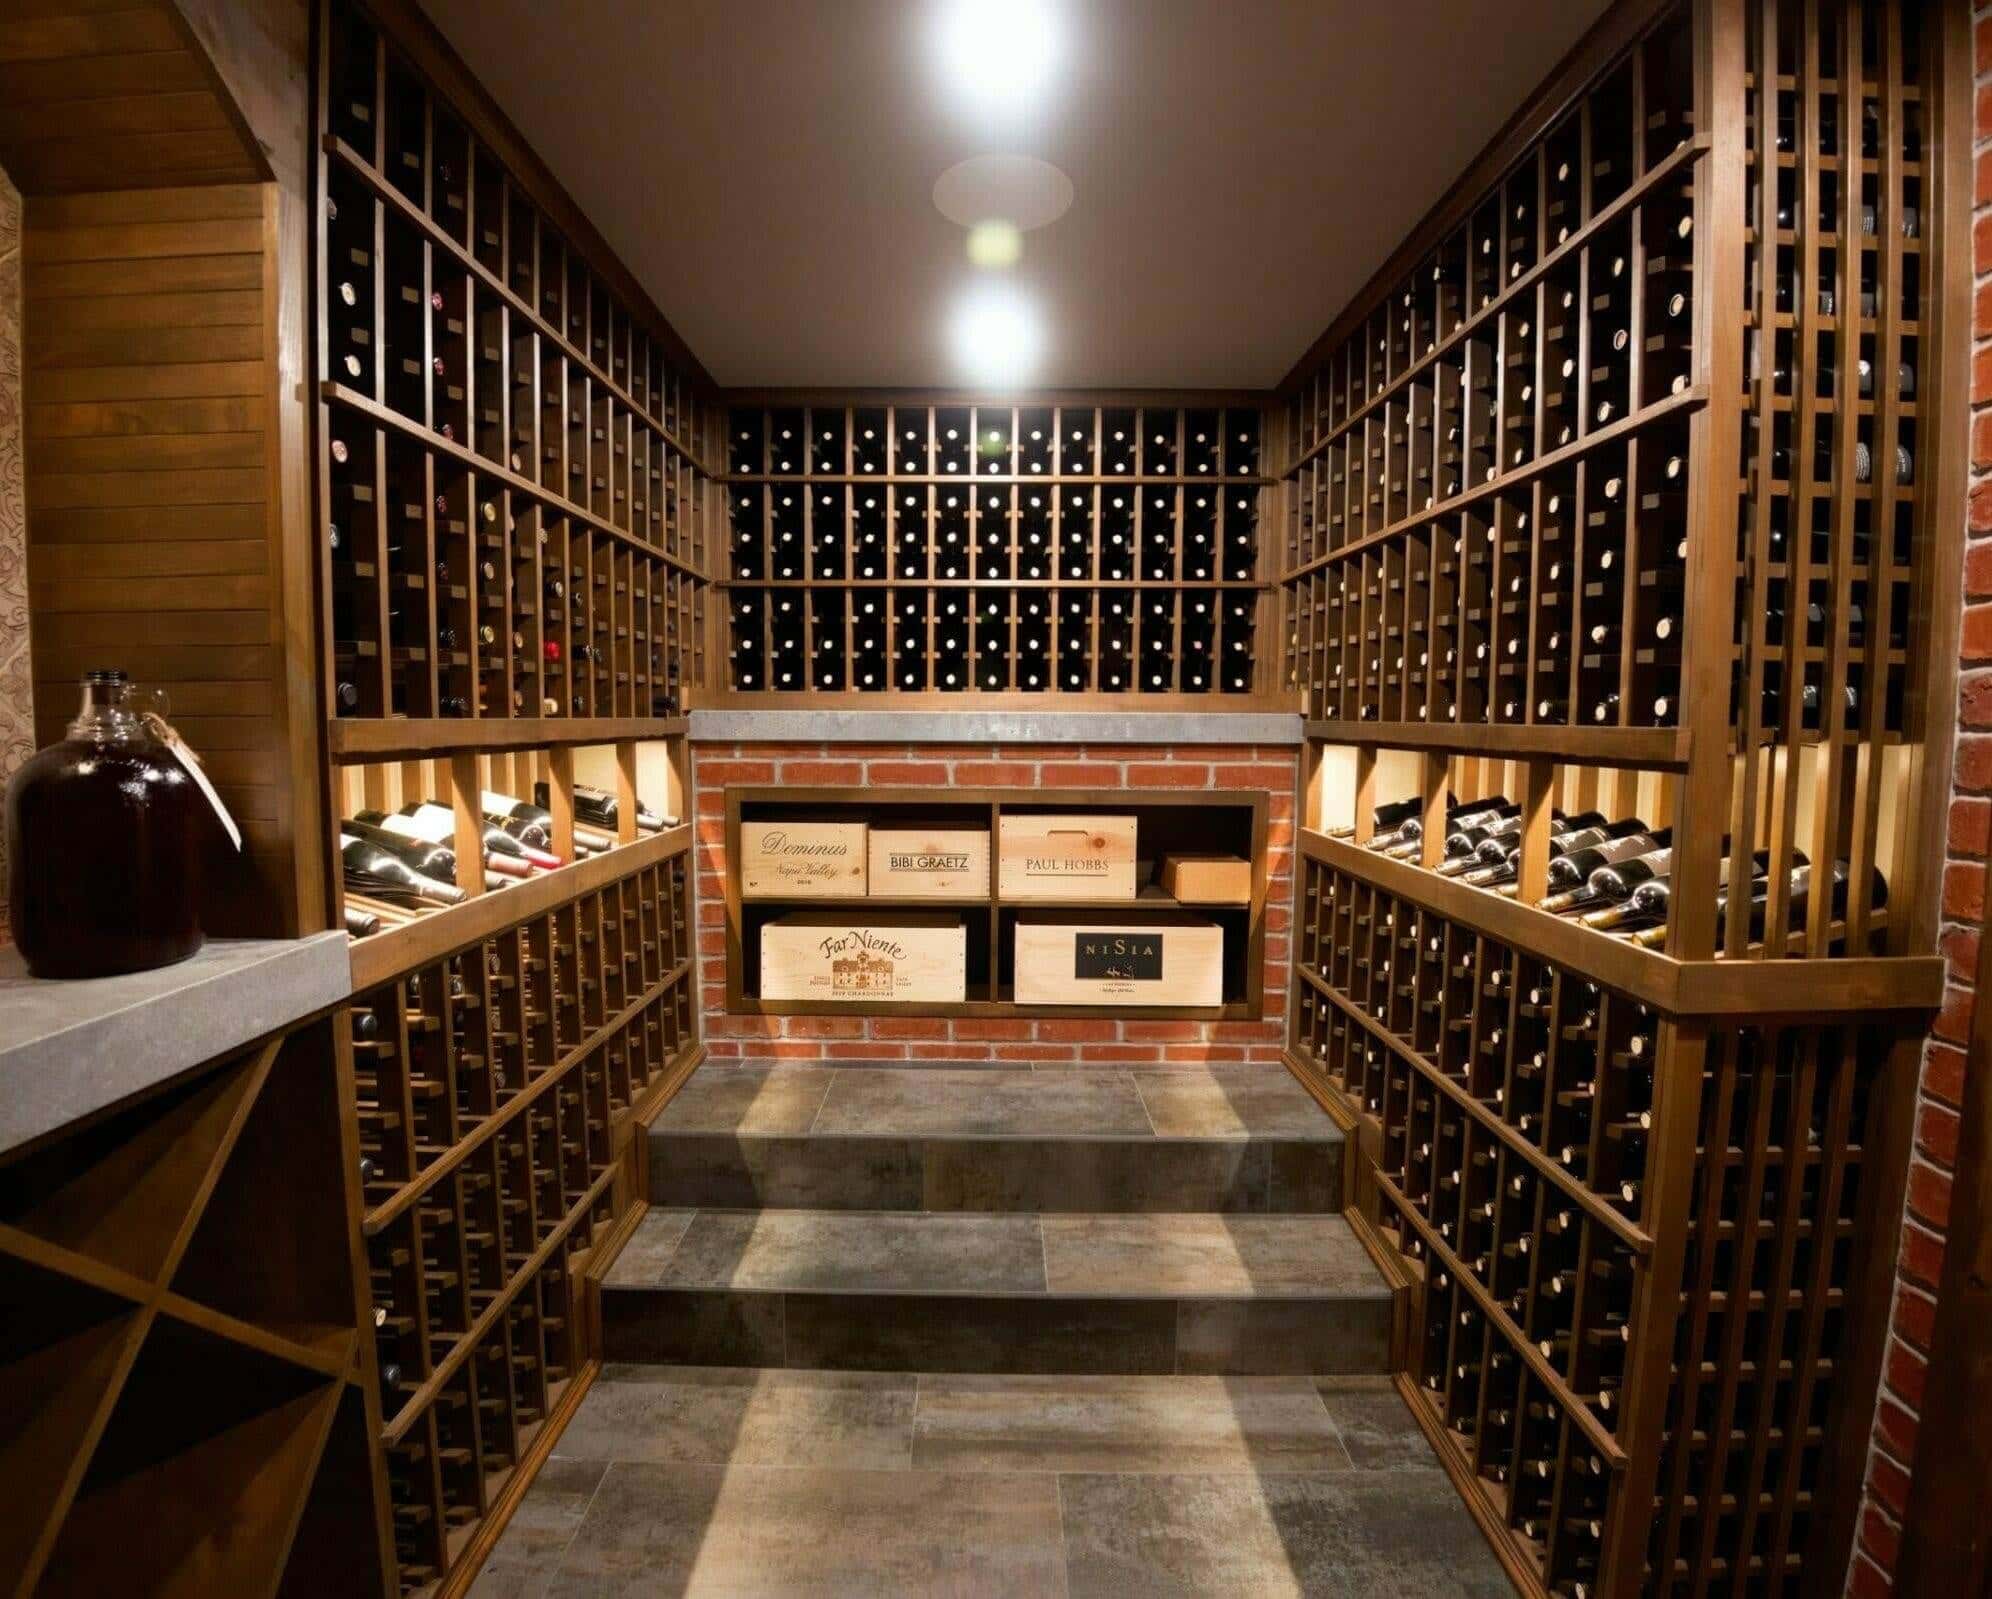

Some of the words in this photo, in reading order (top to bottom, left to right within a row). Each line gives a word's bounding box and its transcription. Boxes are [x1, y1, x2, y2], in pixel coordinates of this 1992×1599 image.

[760, 831, 848, 856] Dominus
[890, 856, 913, 868] BIBI
[917, 856, 969, 868] GRAETZ
[1026, 859, 1060, 871] PAUL
[1065, 859, 1110, 871] HOBBS
[819, 936, 849, 959] Far
[850, 929, 907, 960] Niente
